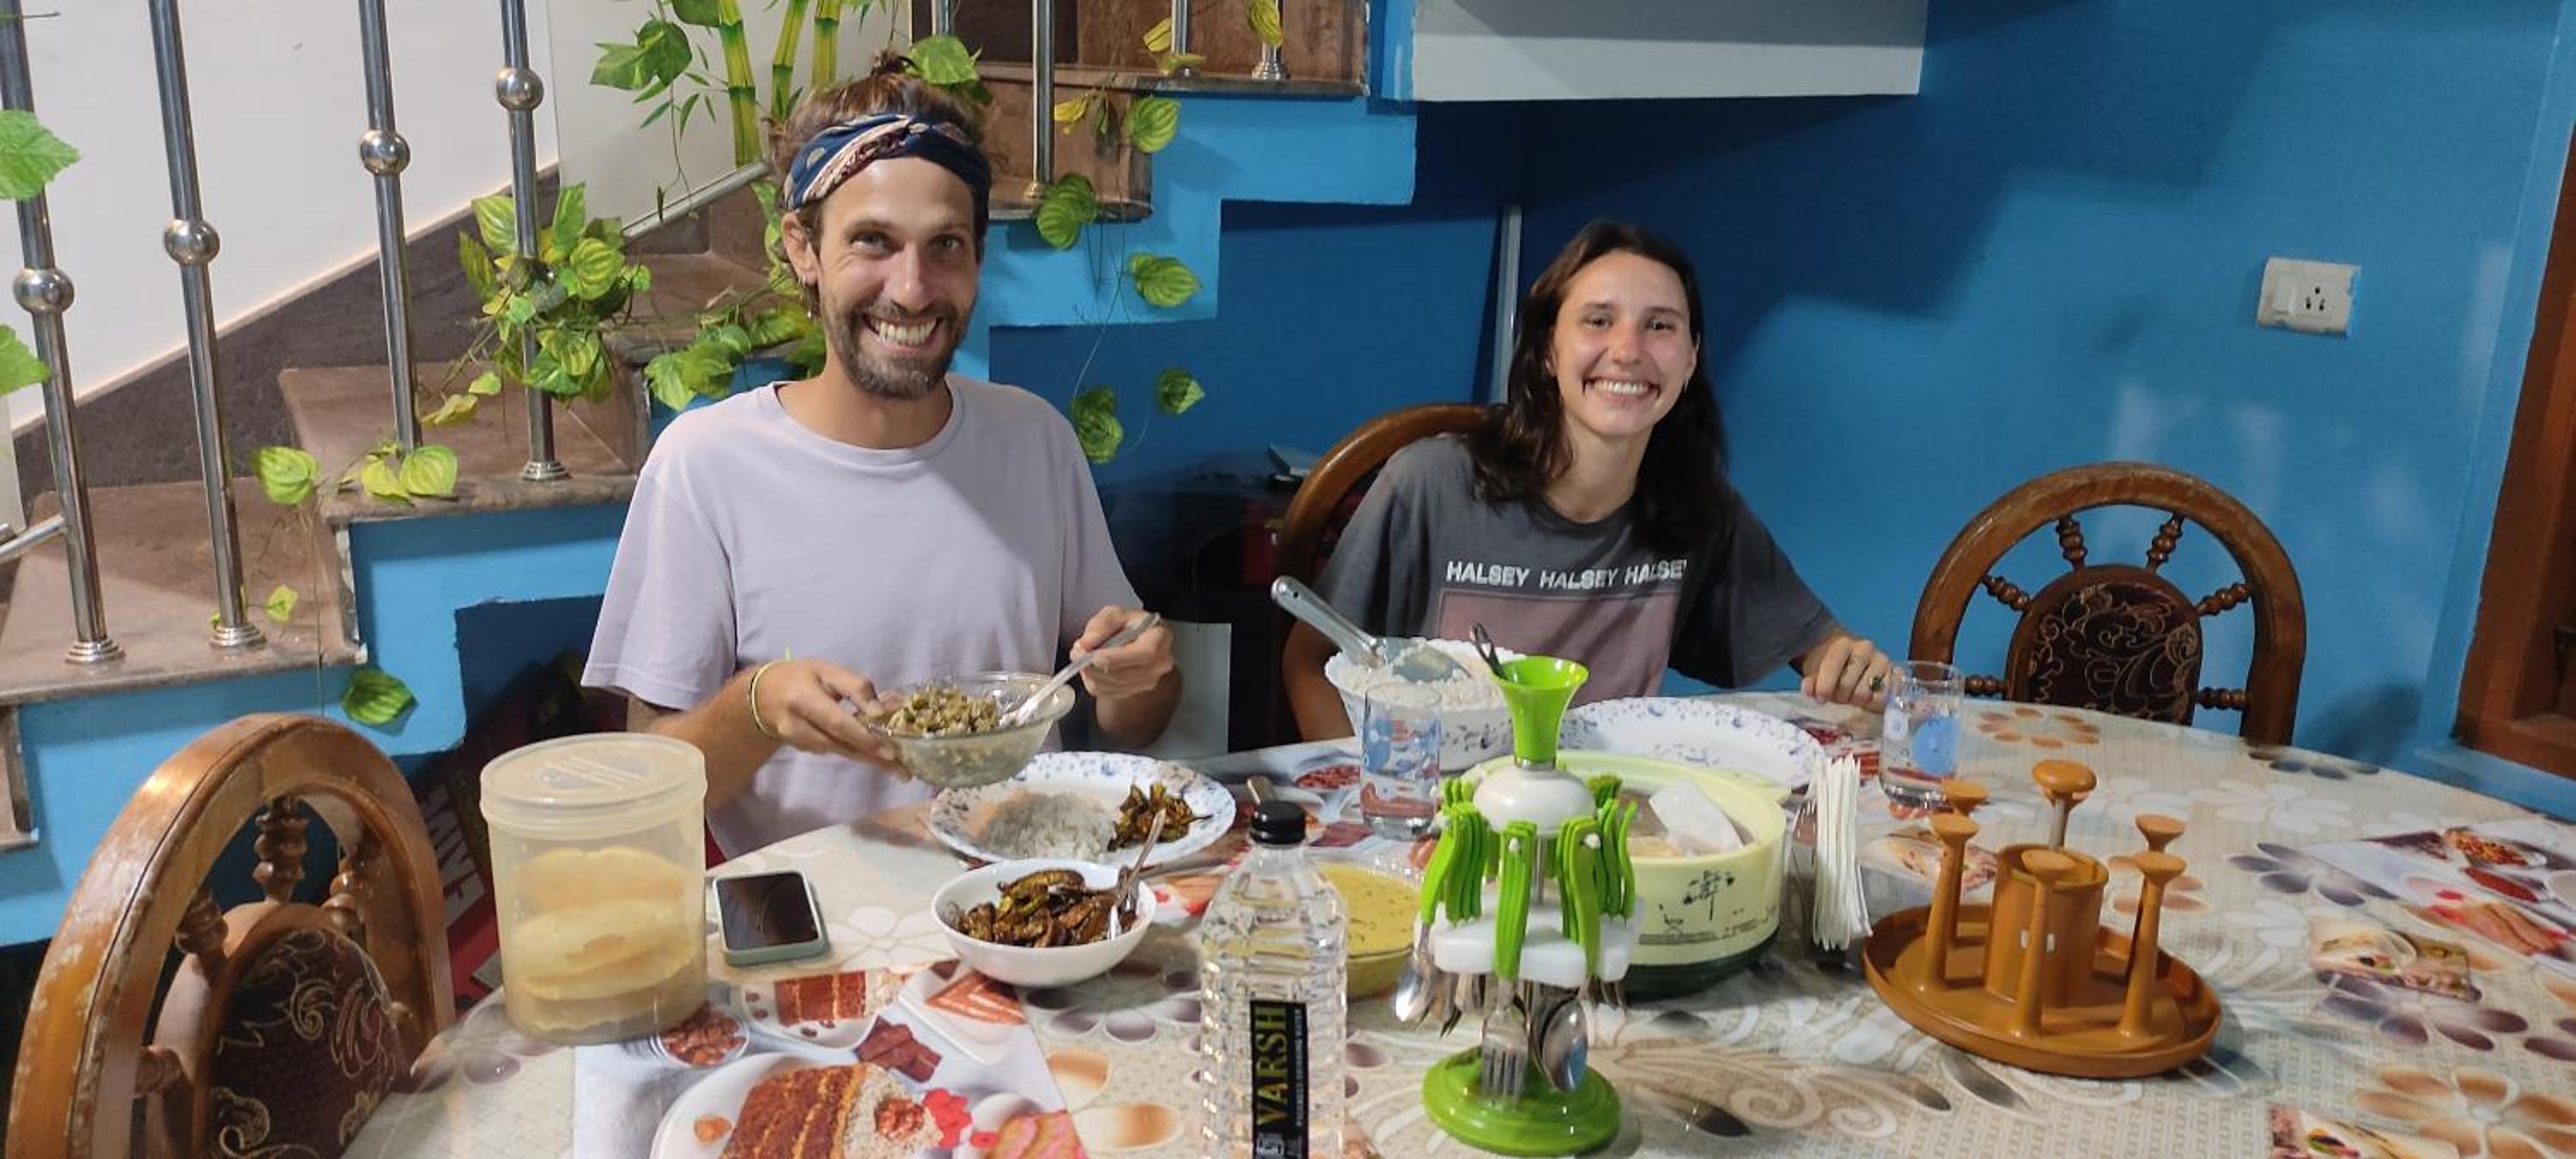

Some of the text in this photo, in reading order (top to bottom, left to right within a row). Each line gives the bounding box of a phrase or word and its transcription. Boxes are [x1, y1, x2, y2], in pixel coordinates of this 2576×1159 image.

[1445, 561, 1530, 587] HALSEY
[1539, 567, 1619, 591] HALSEY
[1255, 1006, 1289, 1126] VARSH
